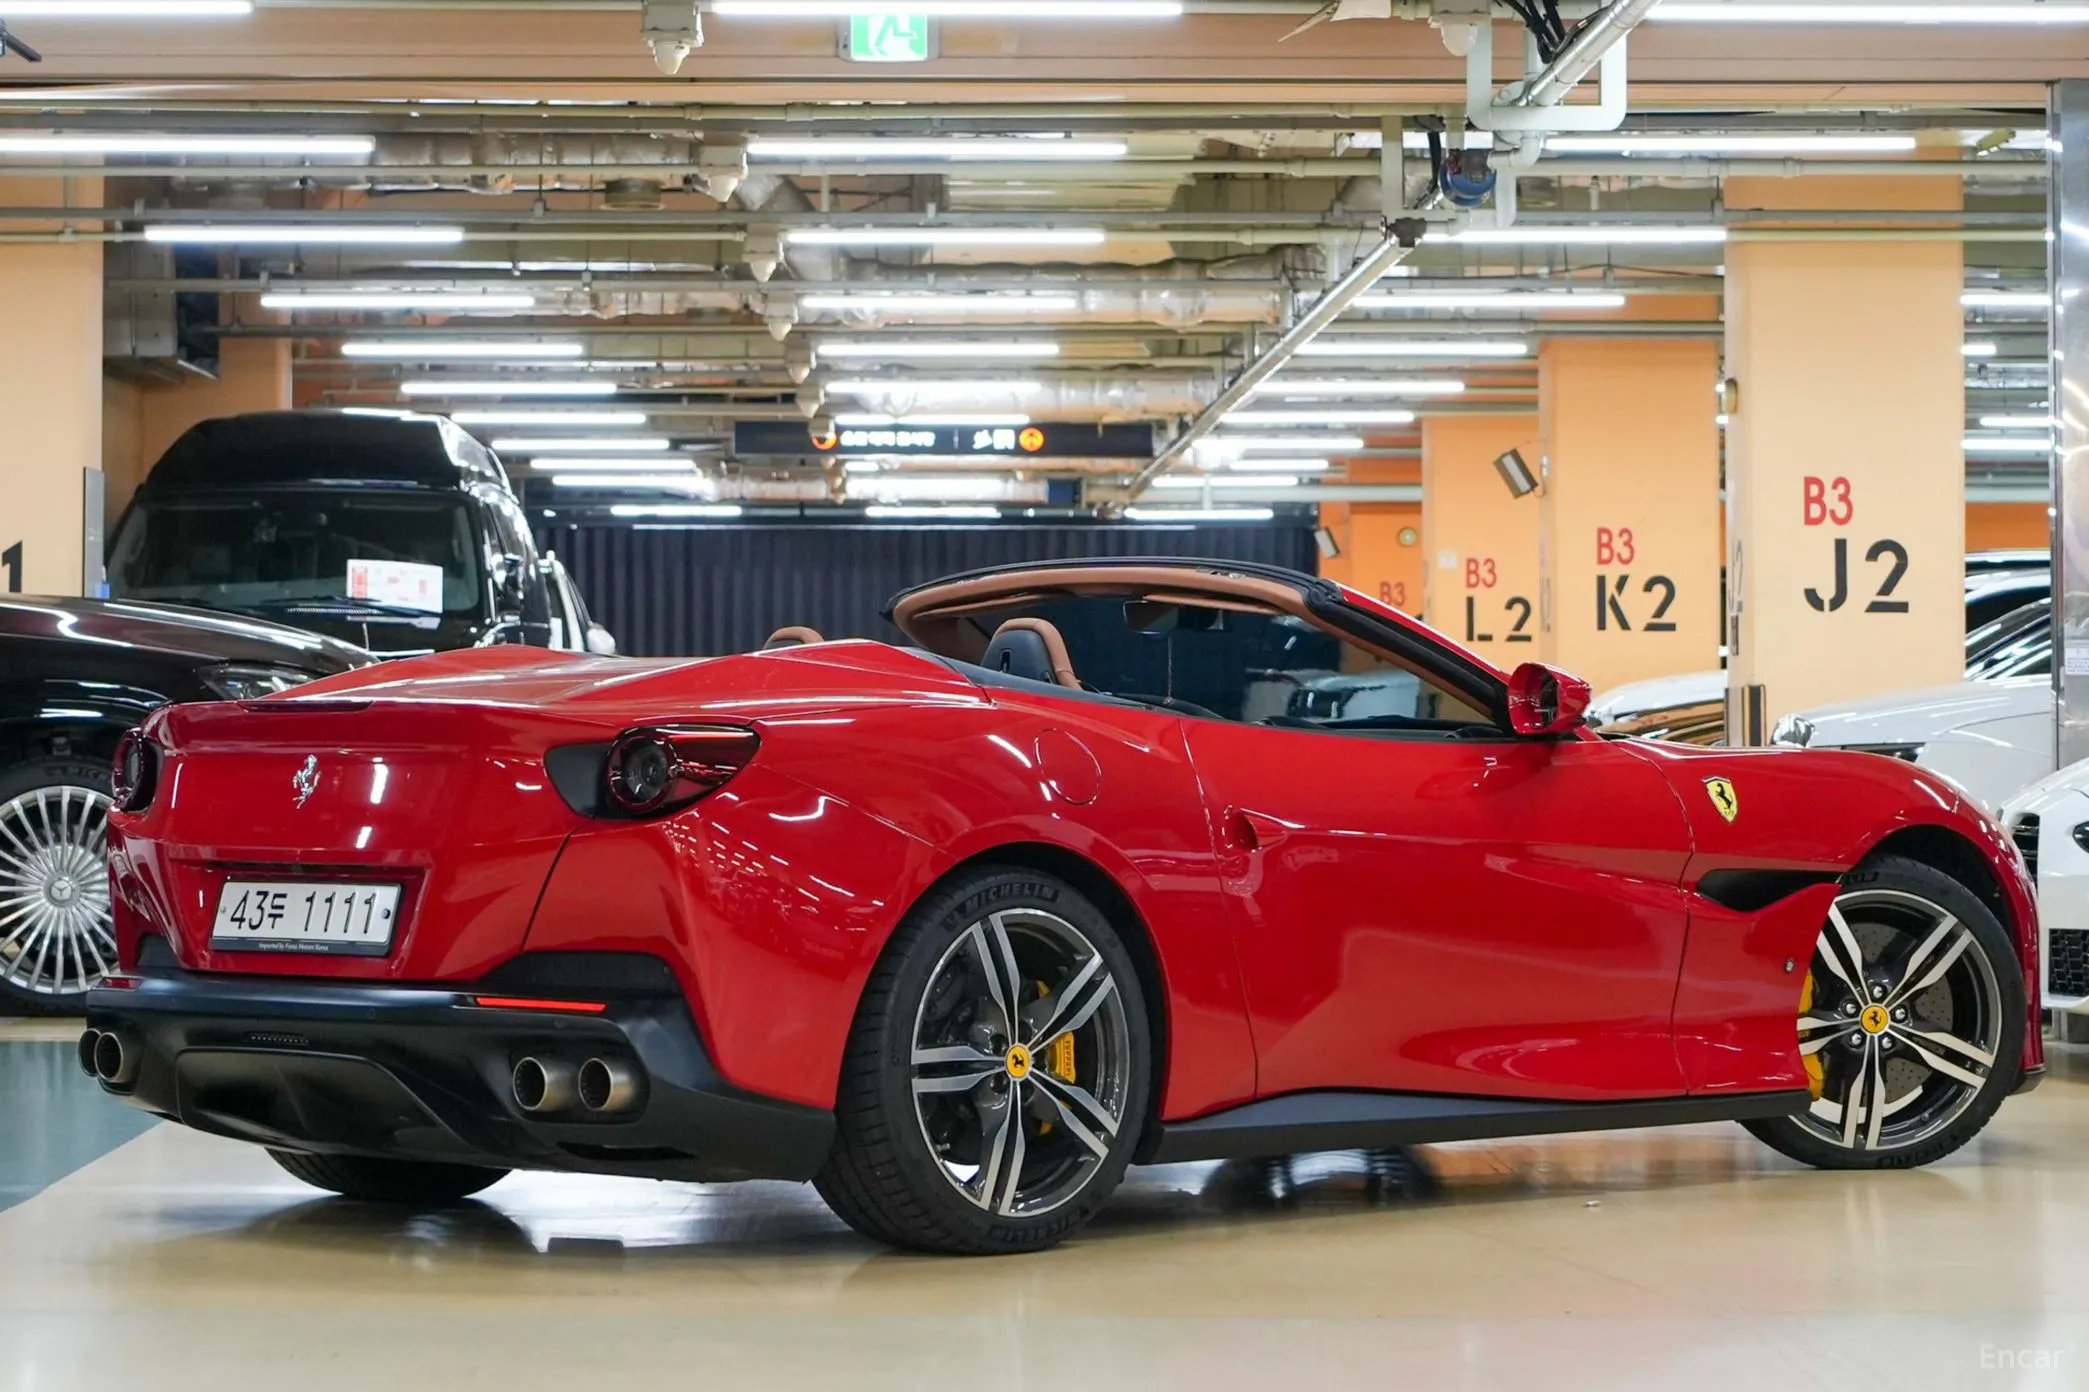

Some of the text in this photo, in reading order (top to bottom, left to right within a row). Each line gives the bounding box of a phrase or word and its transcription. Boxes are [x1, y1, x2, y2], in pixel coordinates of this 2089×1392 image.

[1803, 476, 1854, 526] B3
[1596, 527, 1635, 565] B3
[1379, 581, 1406, 607] B3
[1466, 557, 1497, 588] B3
[1803, 537, 1909, 613] J2
[1466, 596, 1533, 642] L2
[1596, 574, 1677, 631] K2
[230, 889, 377, 934] 43두 1111
[965, 882, 1056, 915] MICHELIN
